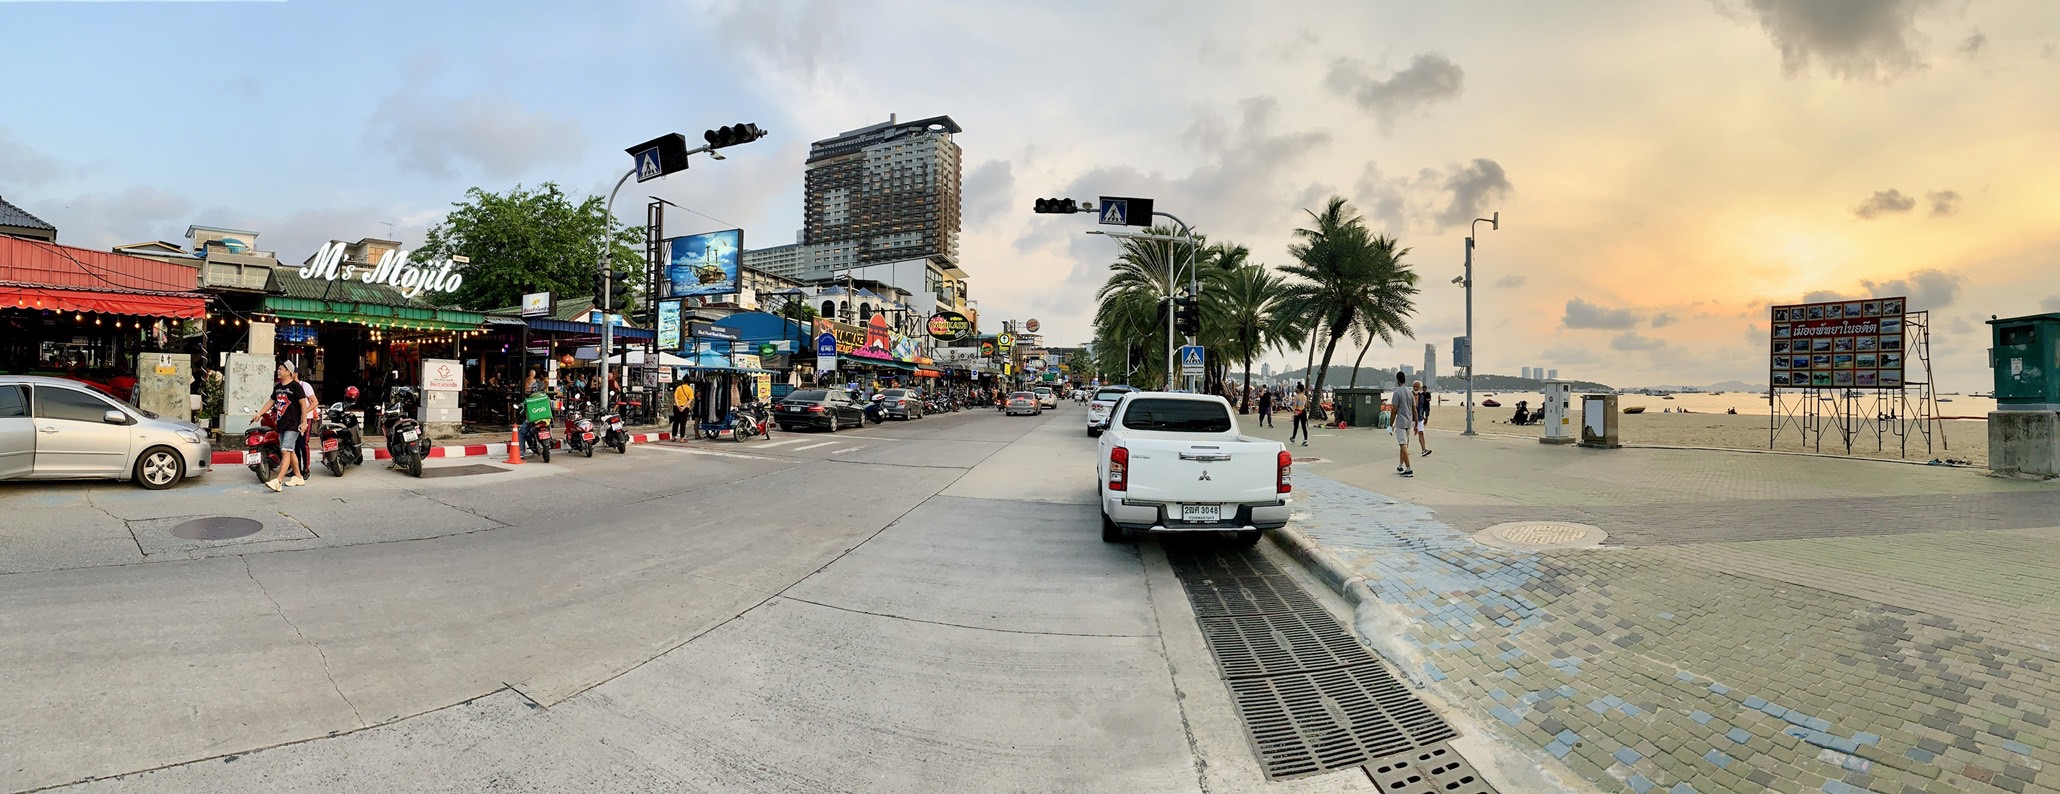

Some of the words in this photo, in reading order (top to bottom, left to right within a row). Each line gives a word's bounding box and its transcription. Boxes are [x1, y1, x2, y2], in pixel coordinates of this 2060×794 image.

[299, 241, 356, 281] M's
[362, 249, 463, 299] Mojito
[1793, 320, 1877, 337] เมืองพัทยาในอดีต
[531, 405, 547, 414] Grab
[1201, 506, 1218, 514] 3048
